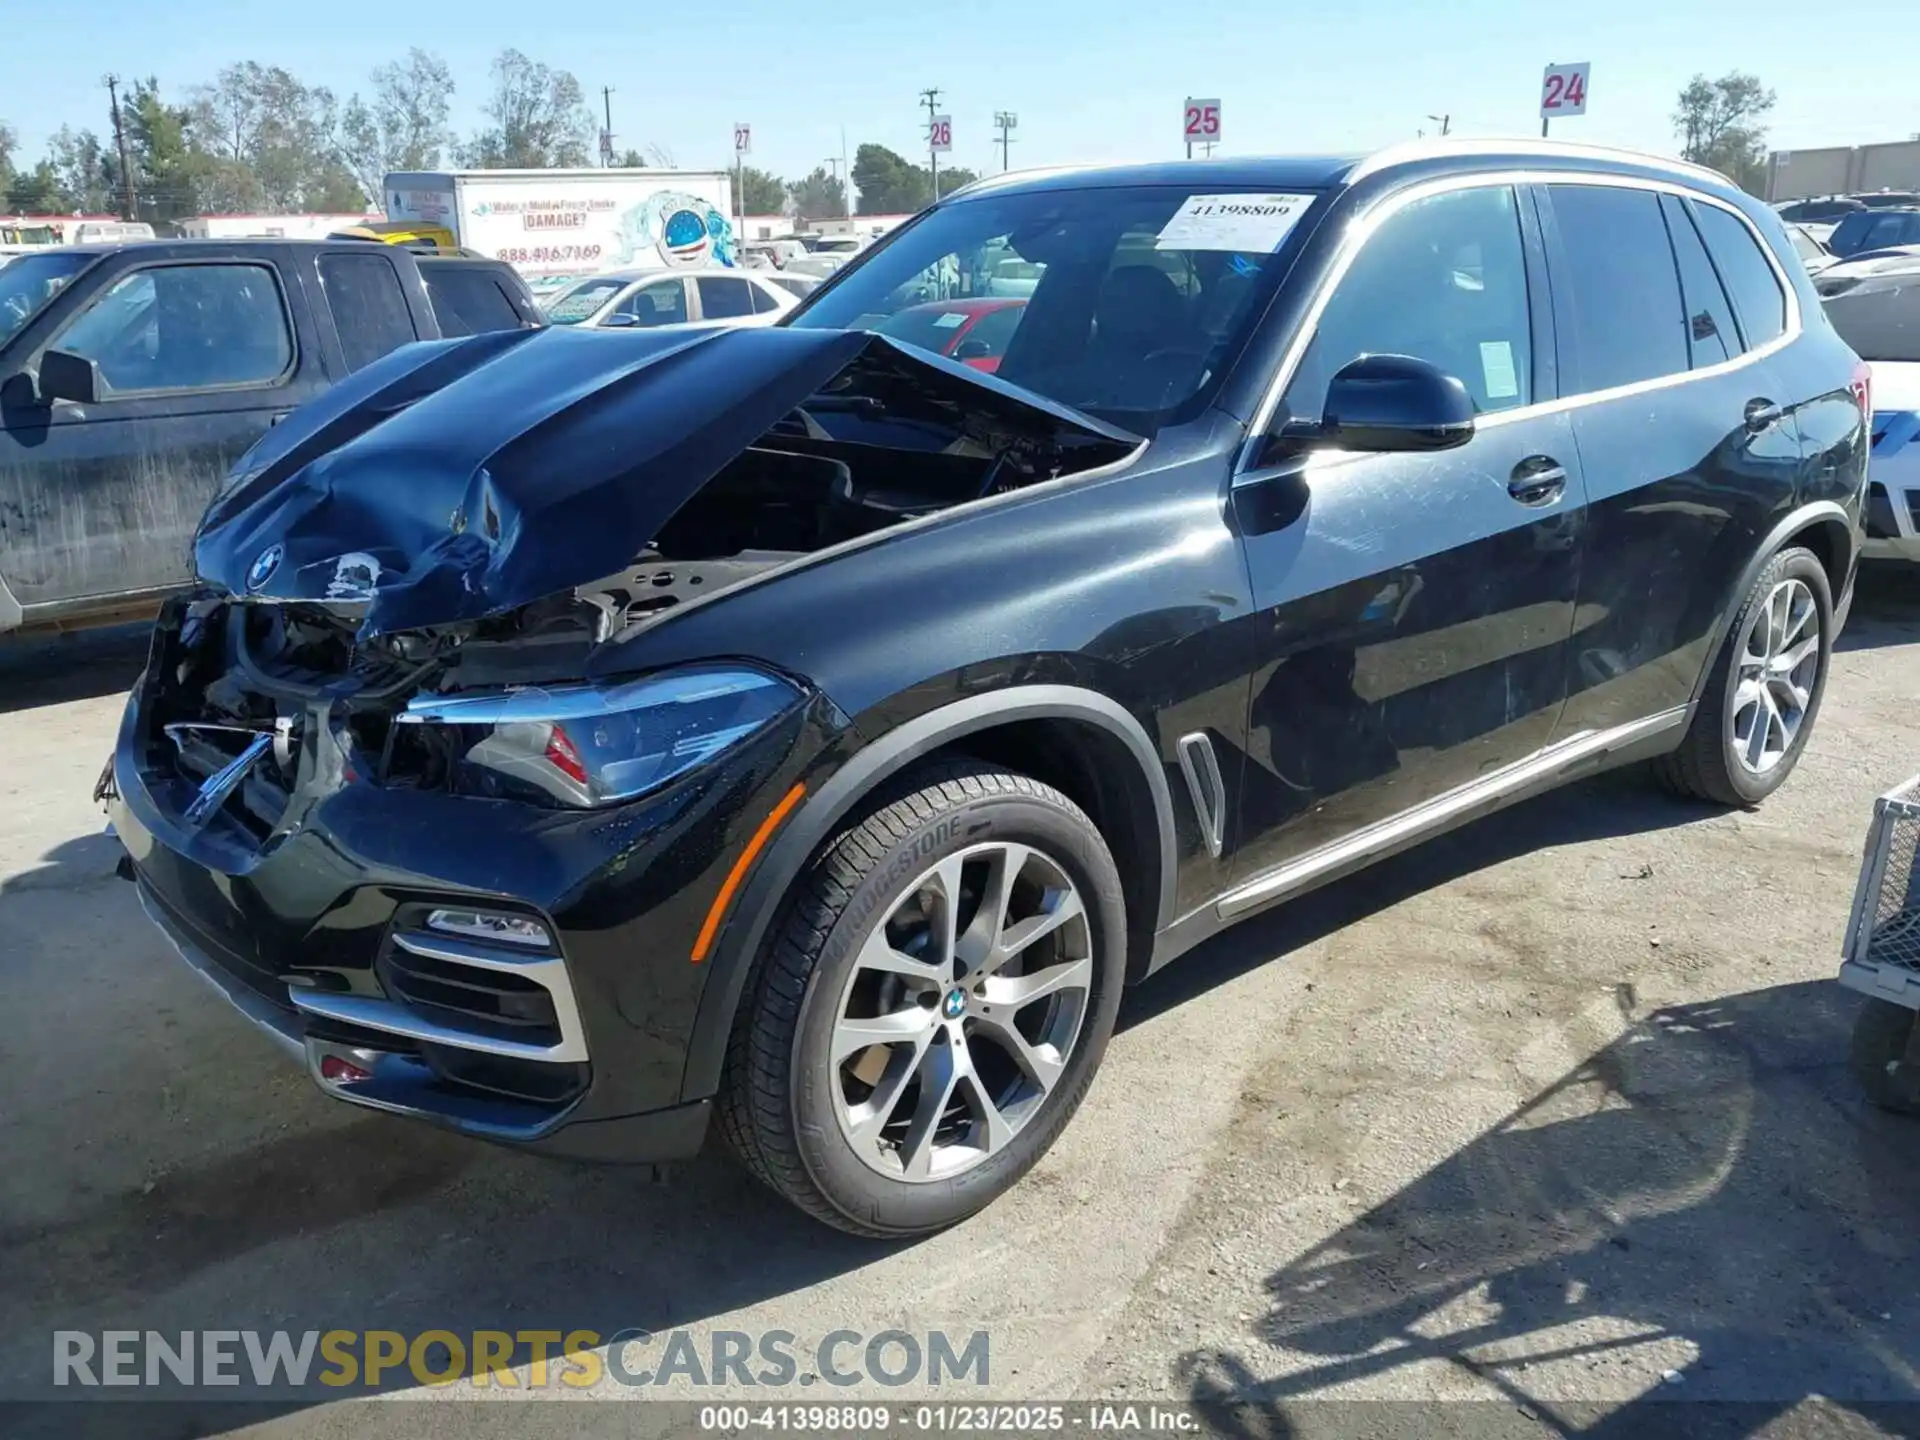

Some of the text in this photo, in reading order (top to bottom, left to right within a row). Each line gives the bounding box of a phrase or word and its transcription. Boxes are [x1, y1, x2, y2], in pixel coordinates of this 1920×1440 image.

[1542, 73, 1585, 109] 24
[1185, 107, 1220, 135] 25
[735, 129, 750, 150] 27
[930, 121, 951, 146] 26
[527, 212, 587, 228] DAMAGE?
[1189, 204, 1291, 216] 41398809
